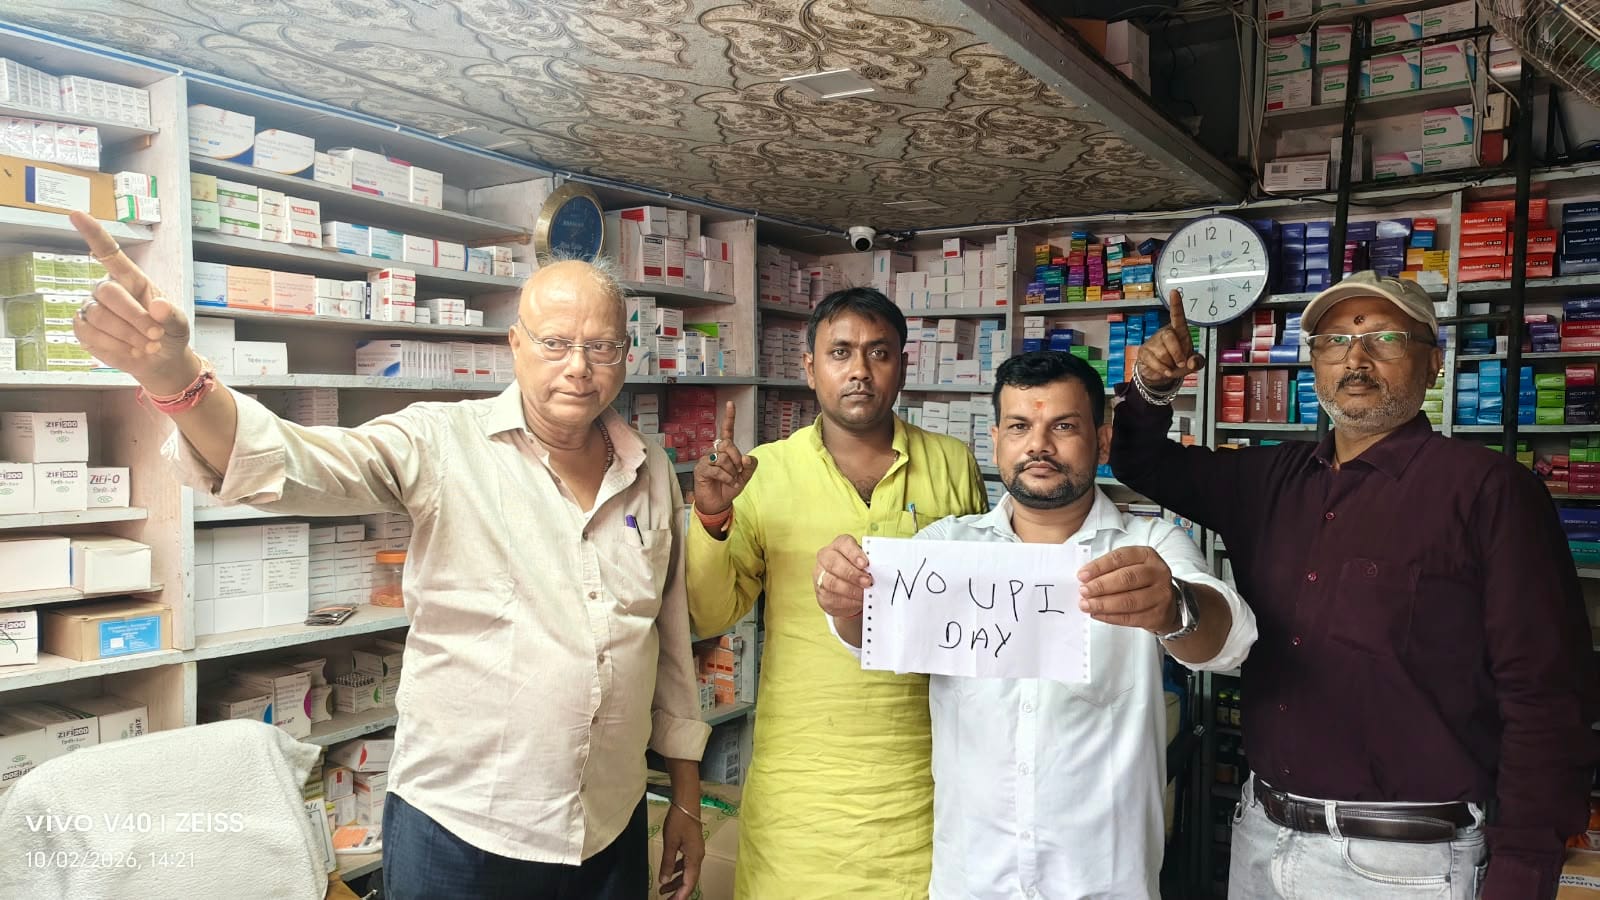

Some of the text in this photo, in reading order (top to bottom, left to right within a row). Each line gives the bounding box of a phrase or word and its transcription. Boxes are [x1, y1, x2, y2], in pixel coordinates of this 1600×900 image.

[1205, 226, 1217, 241] 12
[1187, 234, 1197, 249] 11
[1241, 241, 1251, 255] 2
[1172, 249, 1186, 264] 10
[1247, 259, 1257, 271] 3
[1242, 280, 1252, 293] 4
[1189, 298, 1199, 313] 7
[1208, 300, 1218, 317] 6
[1228, 294, 1237, 308] 5
[891, 557, 1064, 622] NO UPI
[938, 621, 1012, 658] DAY
